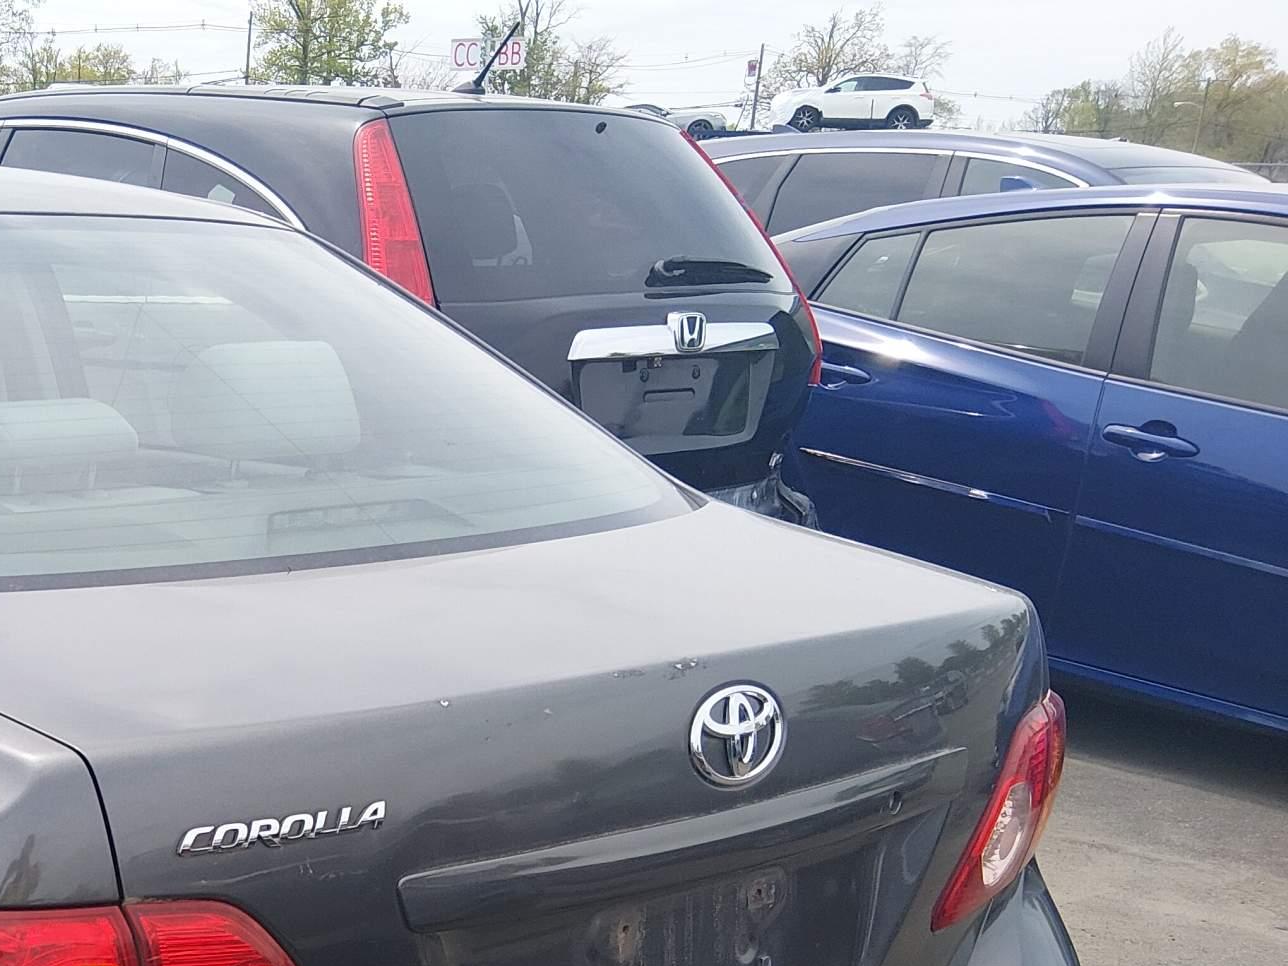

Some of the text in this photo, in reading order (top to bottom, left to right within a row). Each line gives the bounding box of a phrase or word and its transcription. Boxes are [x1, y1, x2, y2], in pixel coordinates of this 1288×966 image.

[453, 42, 479, 67] CC
[498, 41, 522, 66] BB
[176, 799, 387, 857] COROLLA
